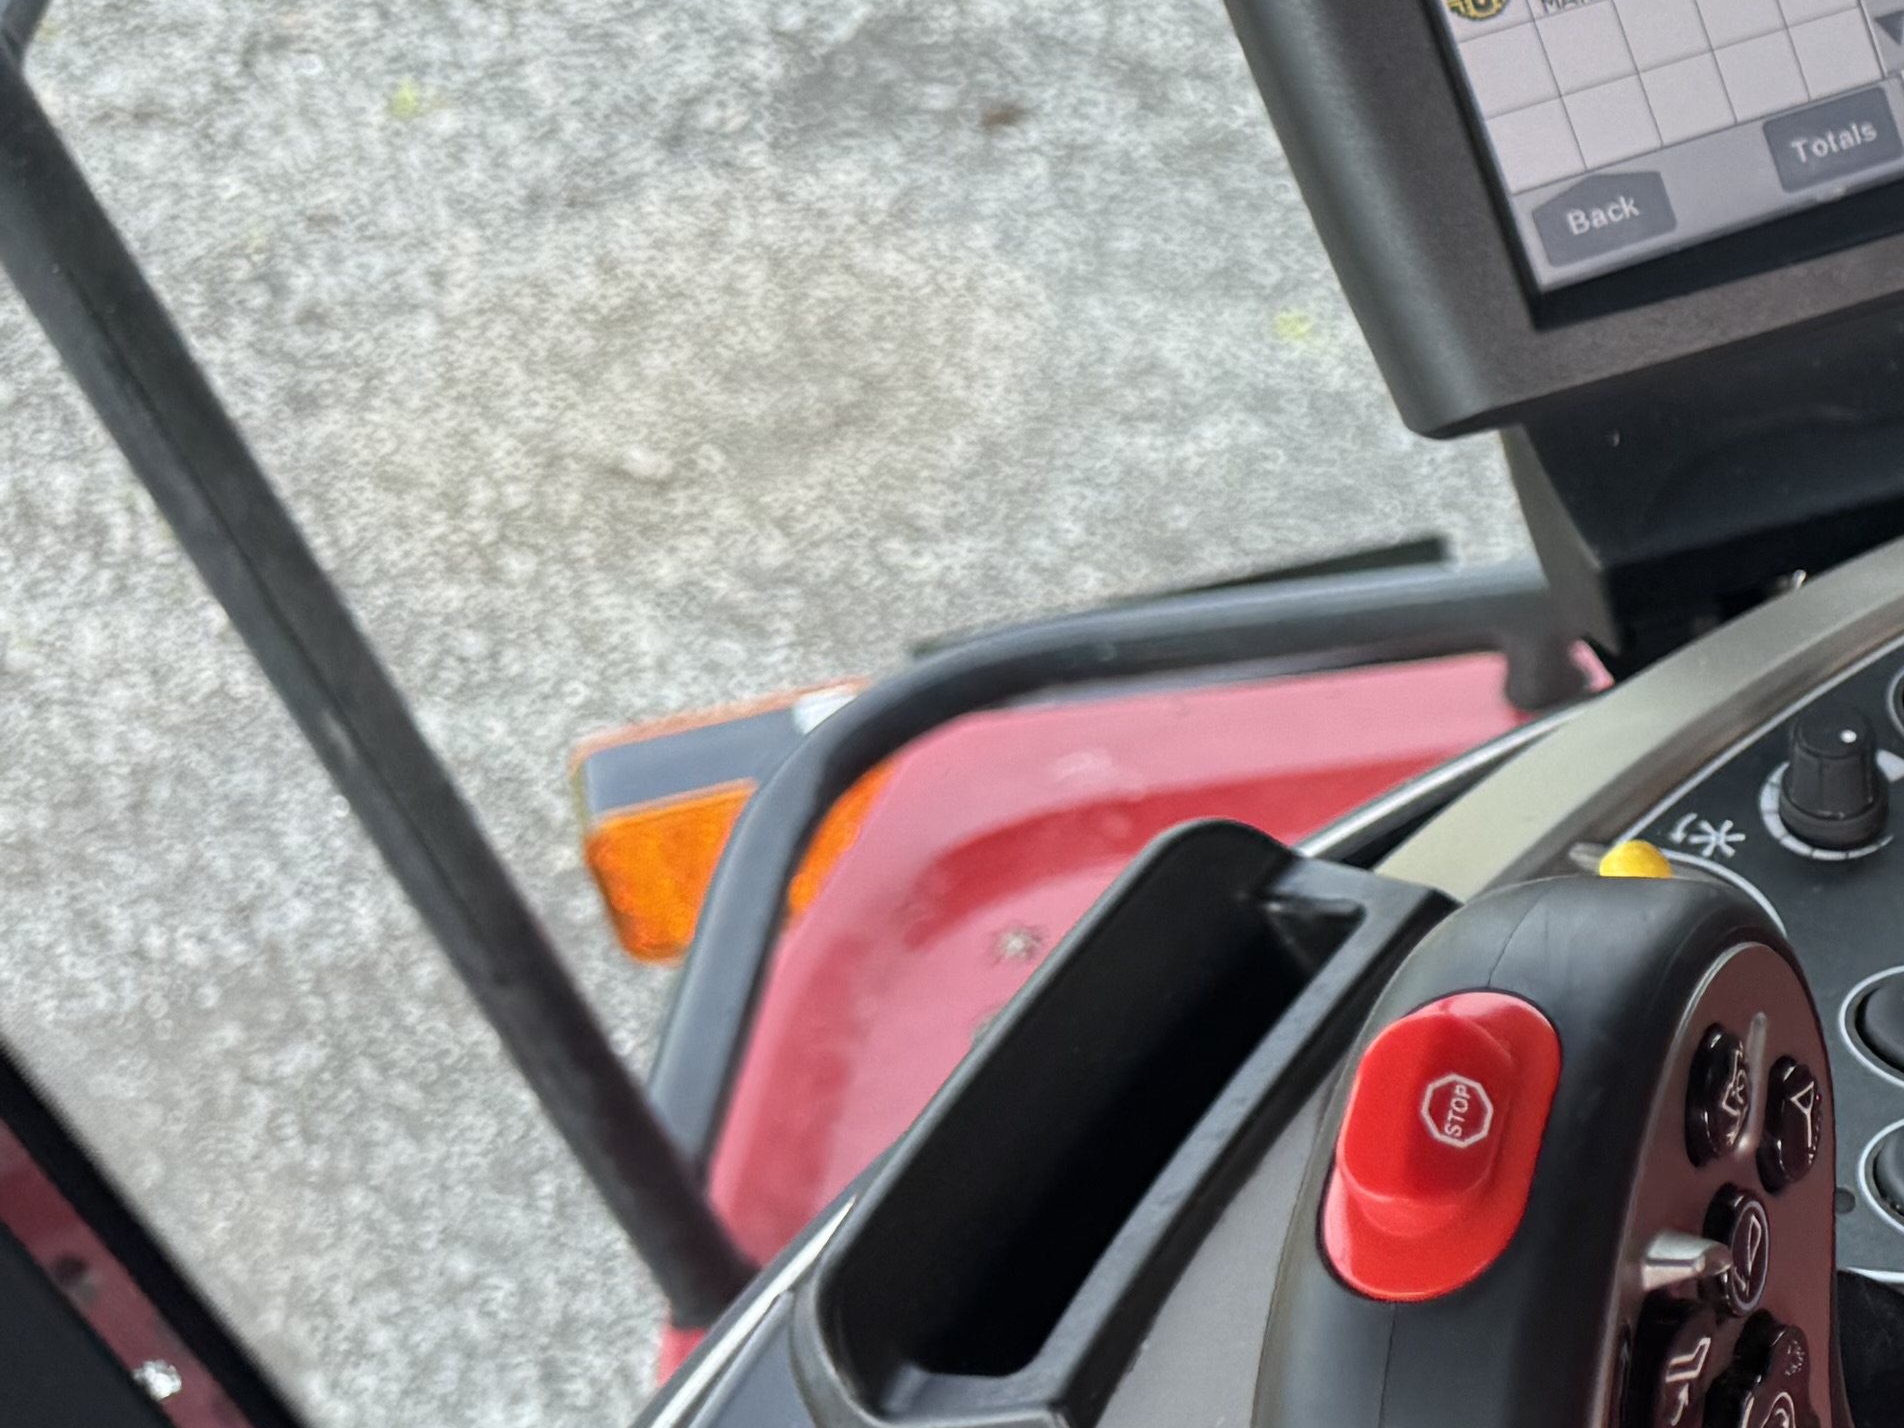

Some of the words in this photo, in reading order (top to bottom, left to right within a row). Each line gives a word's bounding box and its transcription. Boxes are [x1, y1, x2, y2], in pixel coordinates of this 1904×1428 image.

[1792, 118, 1878, 162] Totals
[1567, 196, 1640, 236] Back
[1444, 1084, 1470, 1137] STOP
